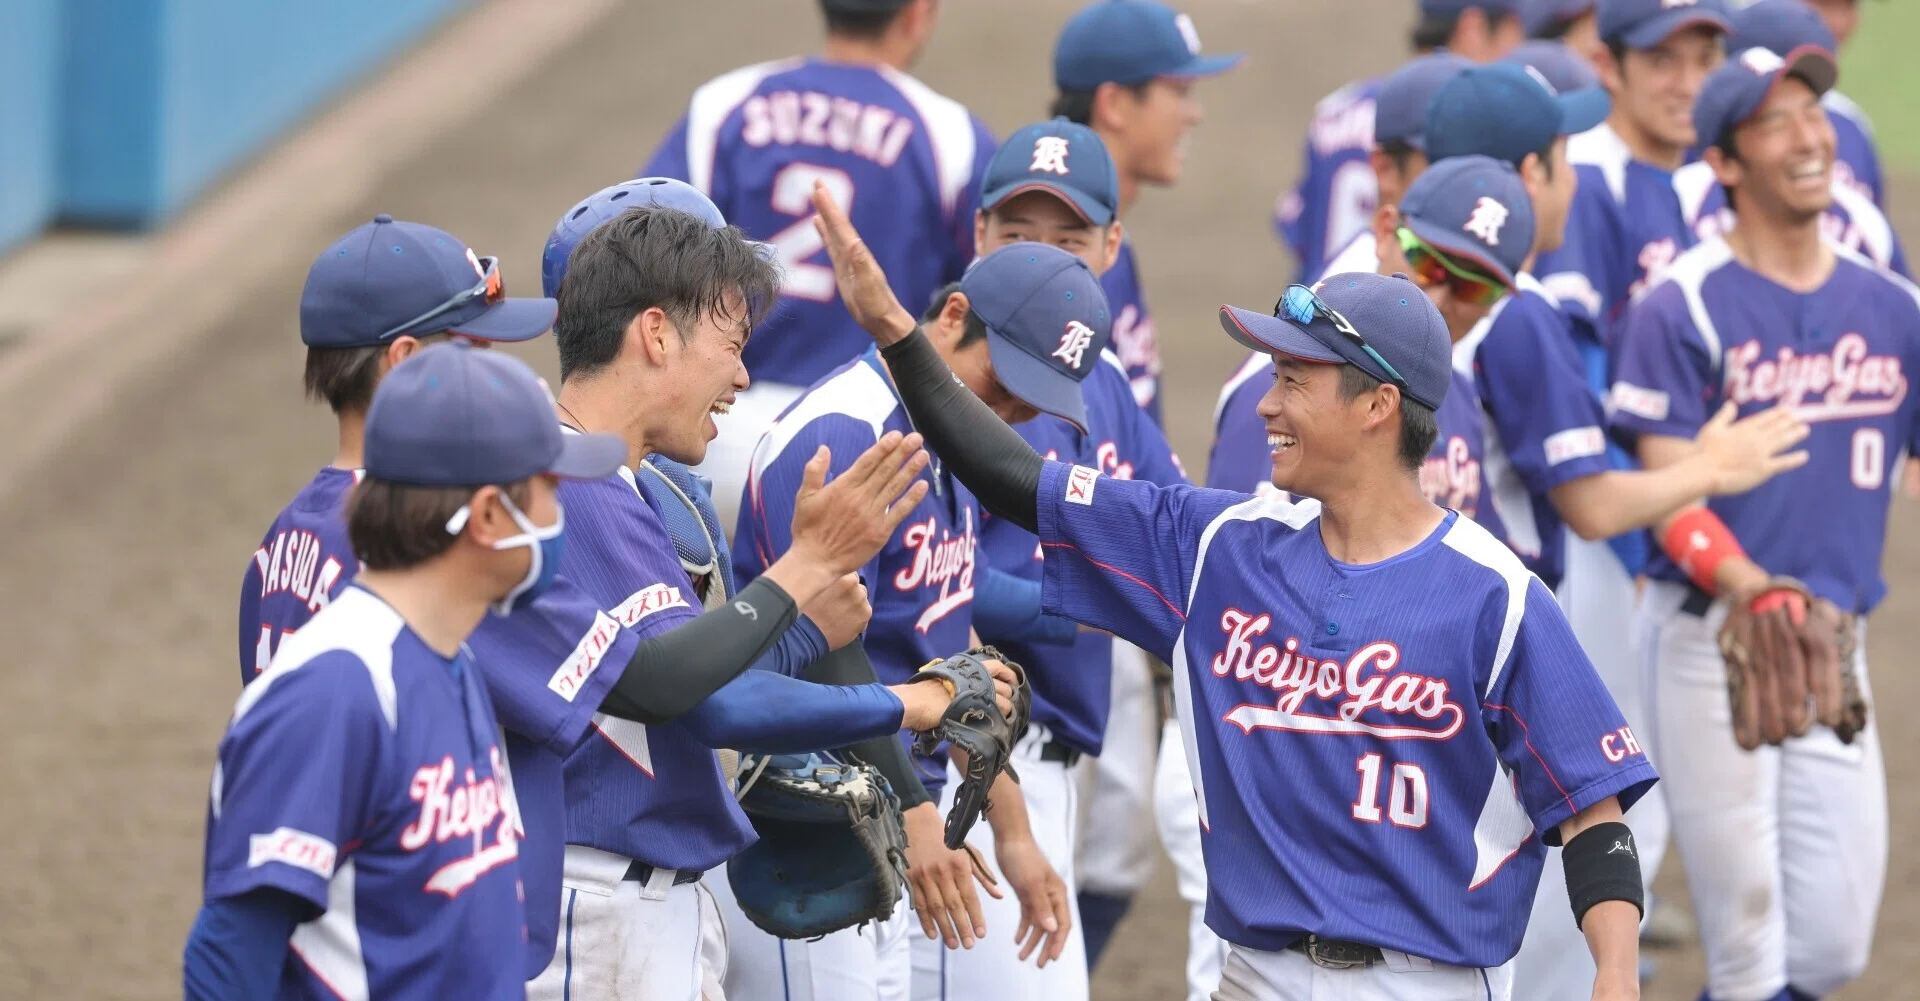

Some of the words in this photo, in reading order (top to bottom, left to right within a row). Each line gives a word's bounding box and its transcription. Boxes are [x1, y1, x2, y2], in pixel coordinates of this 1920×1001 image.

[742, 88, 914, 168] SUZUKI
[768, 162, 854, 303] 2
[1850, 427, 1885, 490] 0
[254, 529, 343, 614] YASUDA
[1211, 606, 1464, 735] KeiyoGas
[1351, 751, 1430, 830] 10
